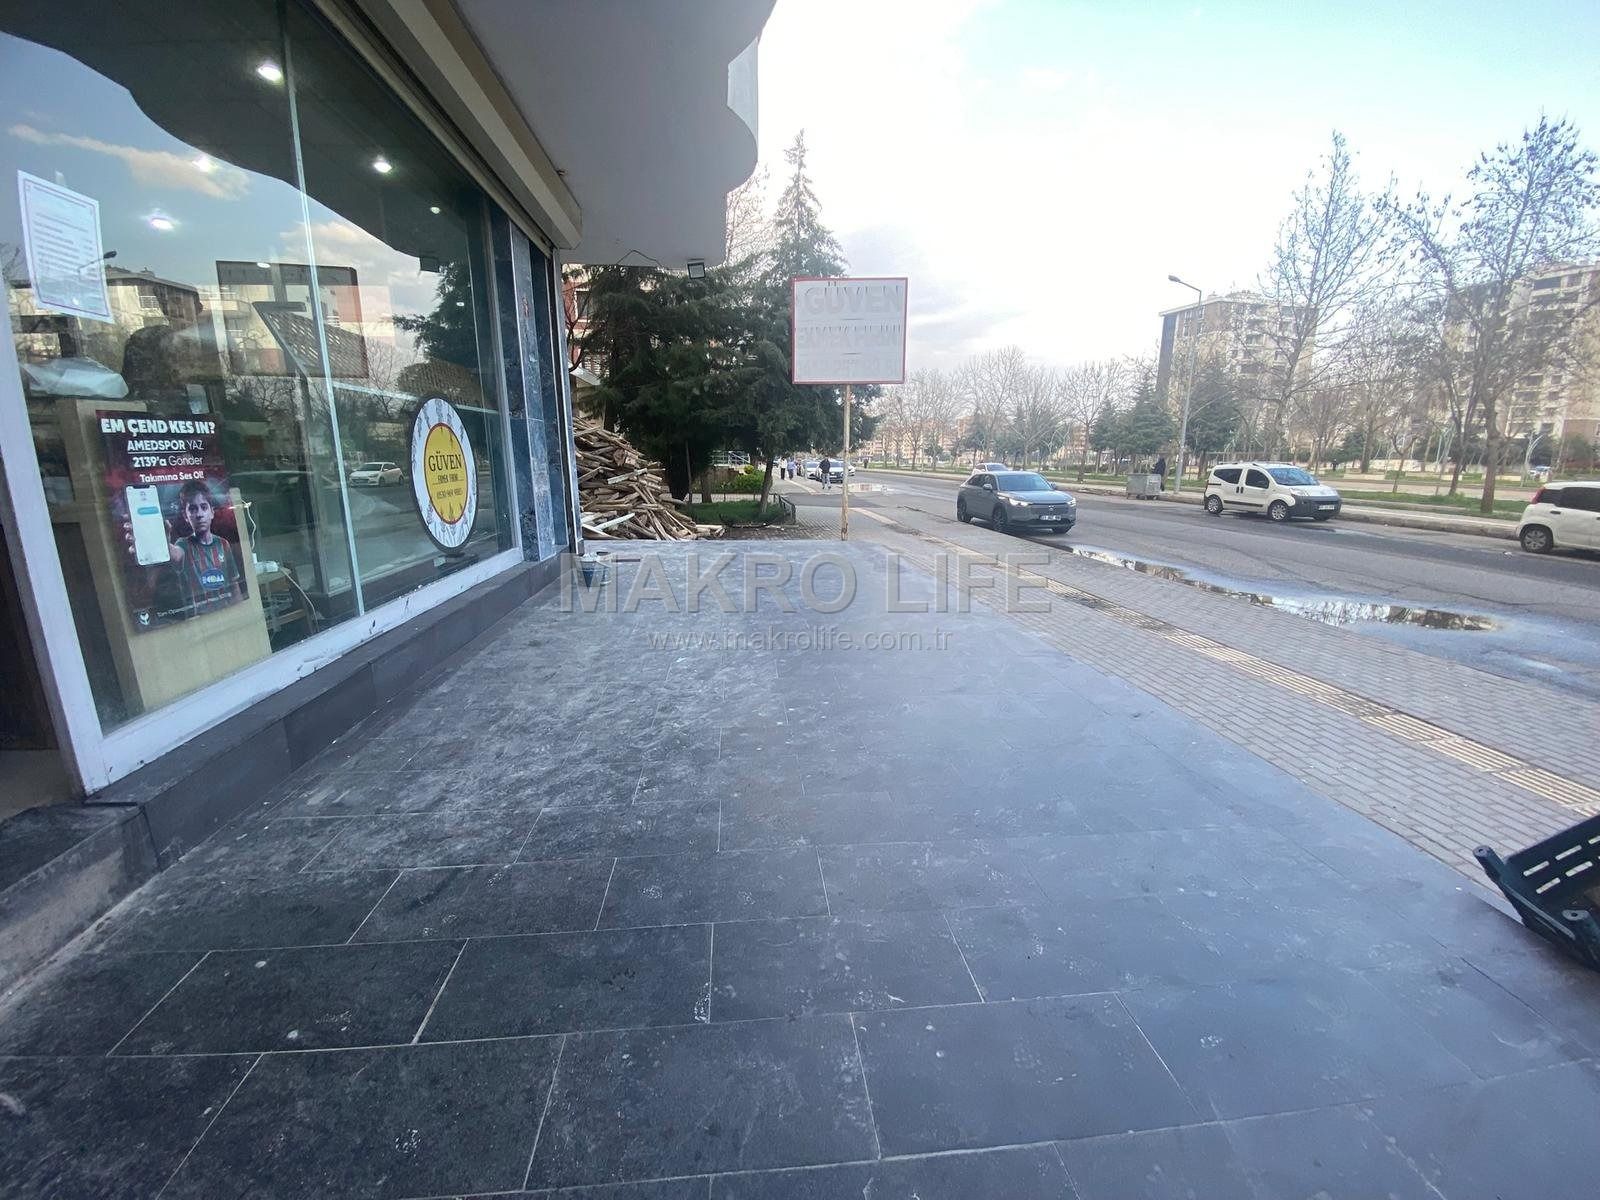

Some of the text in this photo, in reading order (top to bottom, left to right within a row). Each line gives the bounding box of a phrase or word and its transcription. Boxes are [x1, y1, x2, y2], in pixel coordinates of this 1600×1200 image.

[805, 281, 902, 314] GÜVEN
[101, 418, 126, 433] EM
[127, 418, 168, 437] ÇEND
[169, 420, 194, 434] KES
[127, 440, 204, 451] AMEDSPOR YAZ
[132, 456, 167, 468] 2139'a
[428, 451, 463, 472] GÜVEN
[179, 471, 193, 480] Ses
